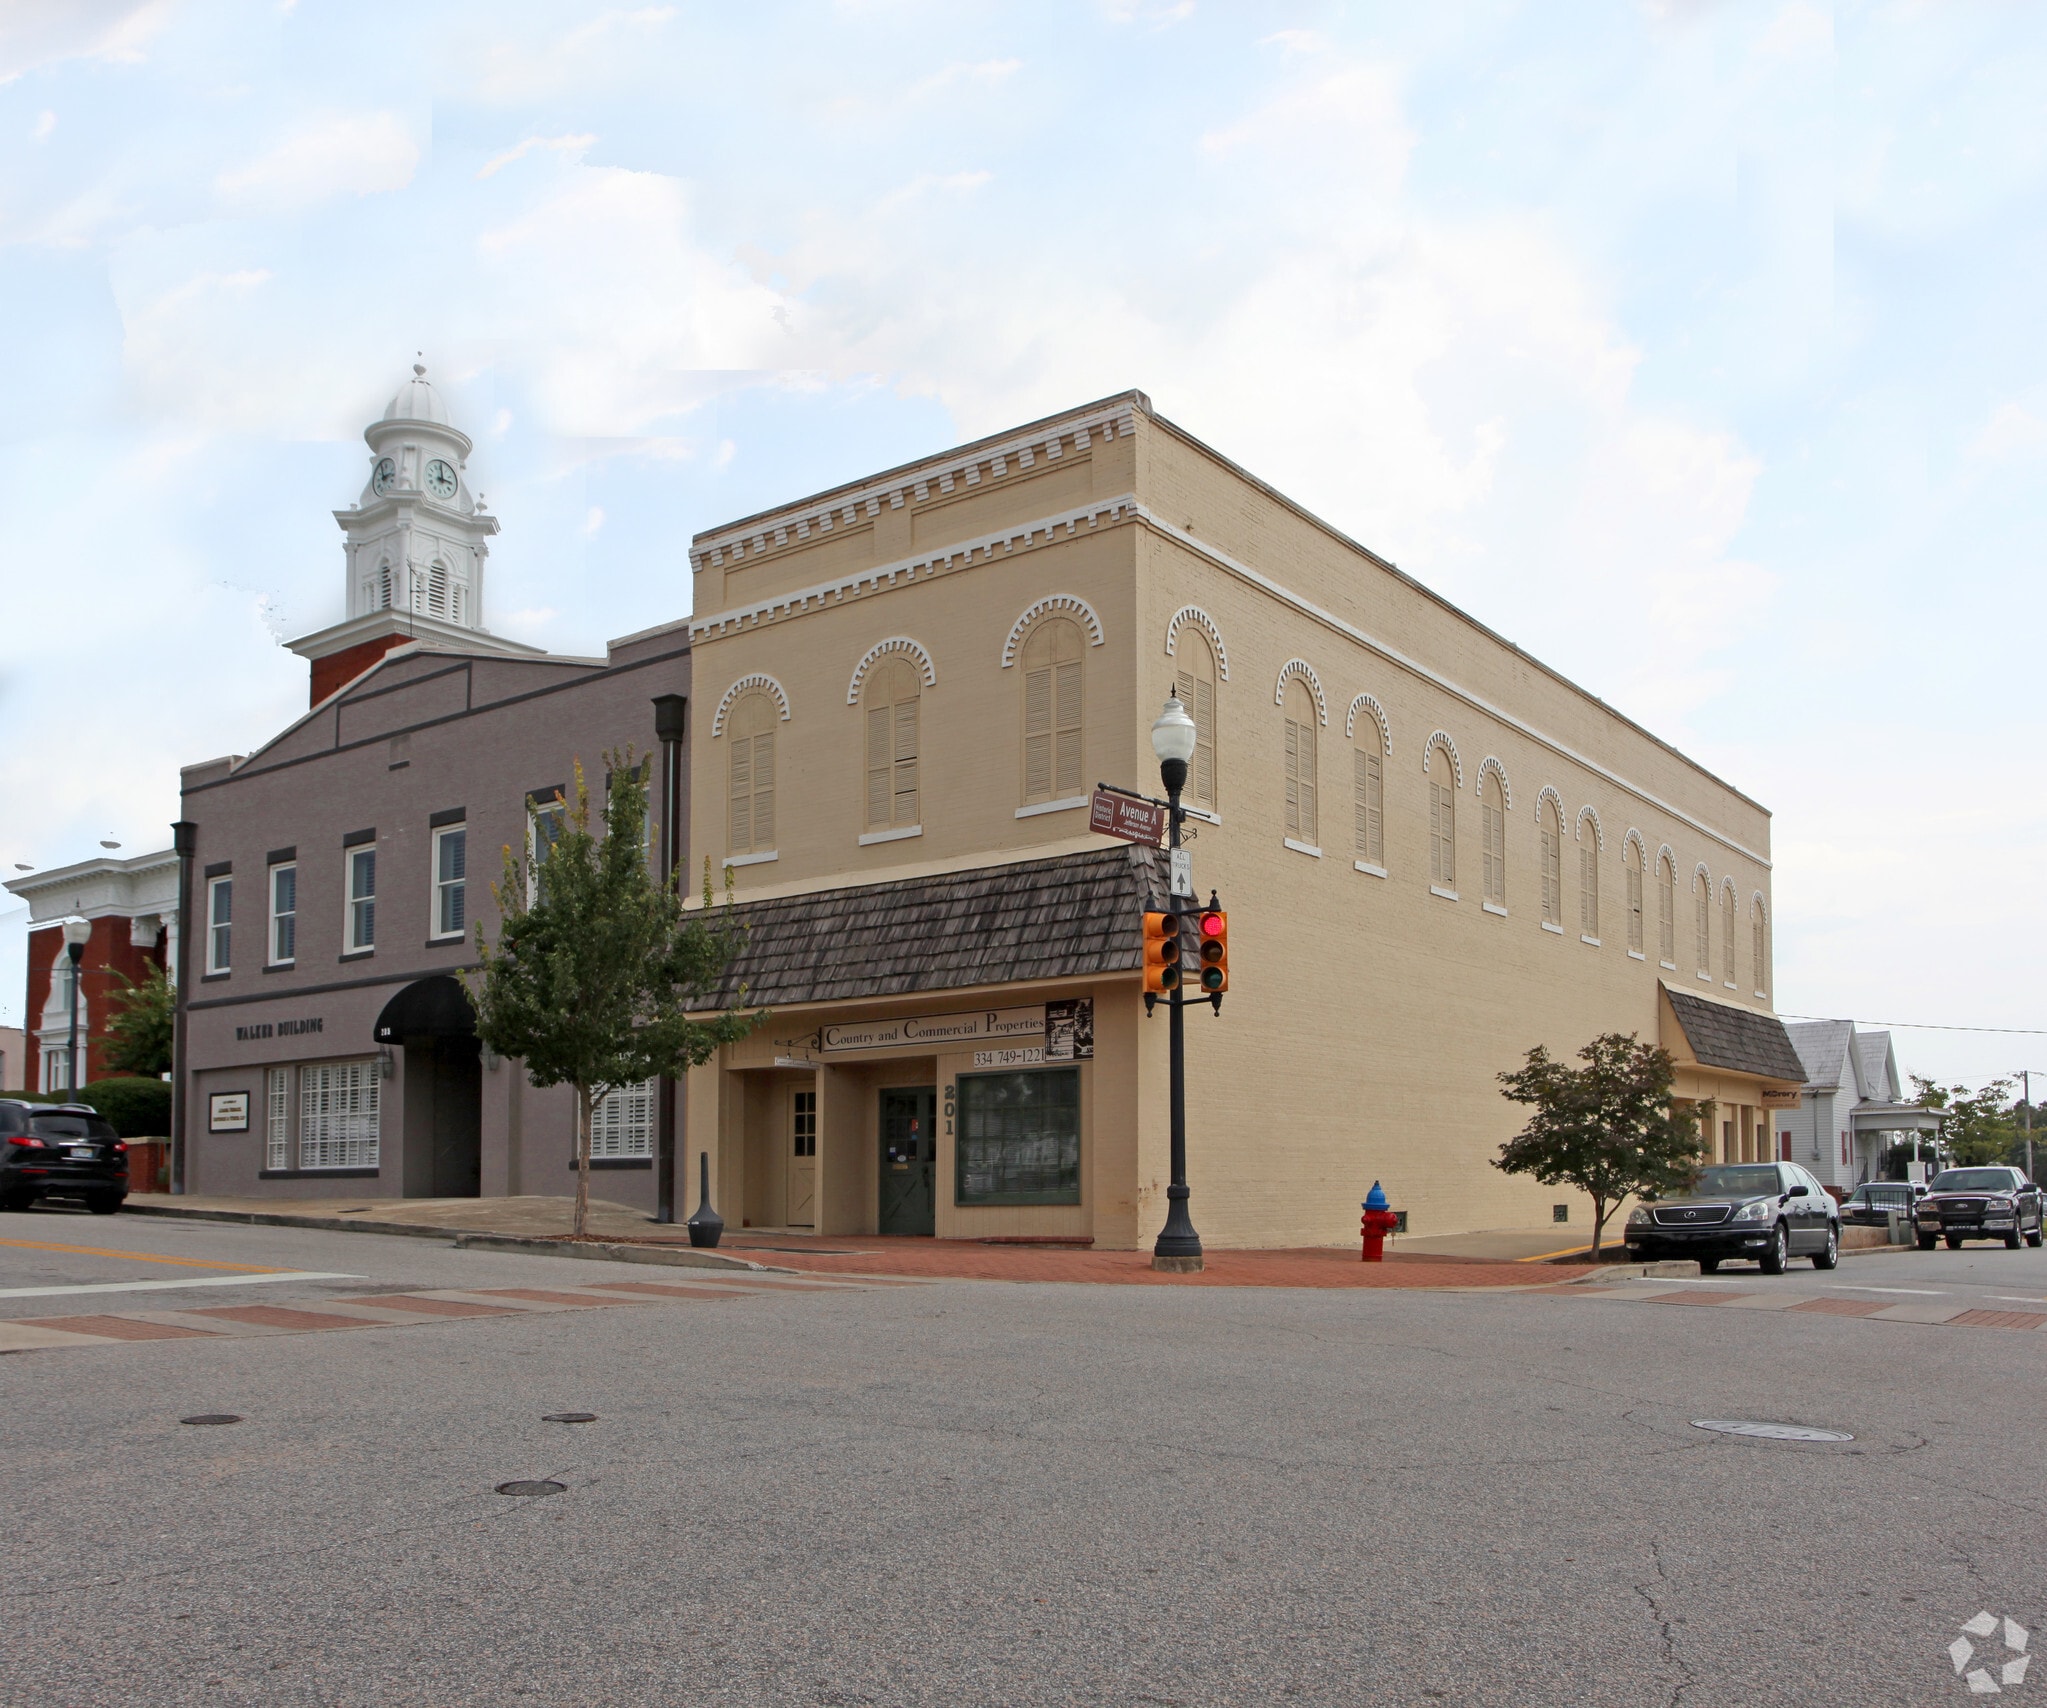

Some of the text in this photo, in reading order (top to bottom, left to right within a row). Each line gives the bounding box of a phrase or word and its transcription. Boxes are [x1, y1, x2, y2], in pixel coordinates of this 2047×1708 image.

[1094, 811, 1111, 822] District
[1095, 803, 1112, 814] Historic
[1120, 801, 1157, 826] Avenue A
[1172, 861, 1190, 870] TRUCKS
[1176, 853, 1186, 861] ALL
[236, 1017, 324, 1041] WALKER BUILDING
[826, 1013, 1044, 1046] Country and Commercial Properties
[974, 1048, 1045, 1066] 334 749-1221
[944, 1085, 956, 1136] 201
